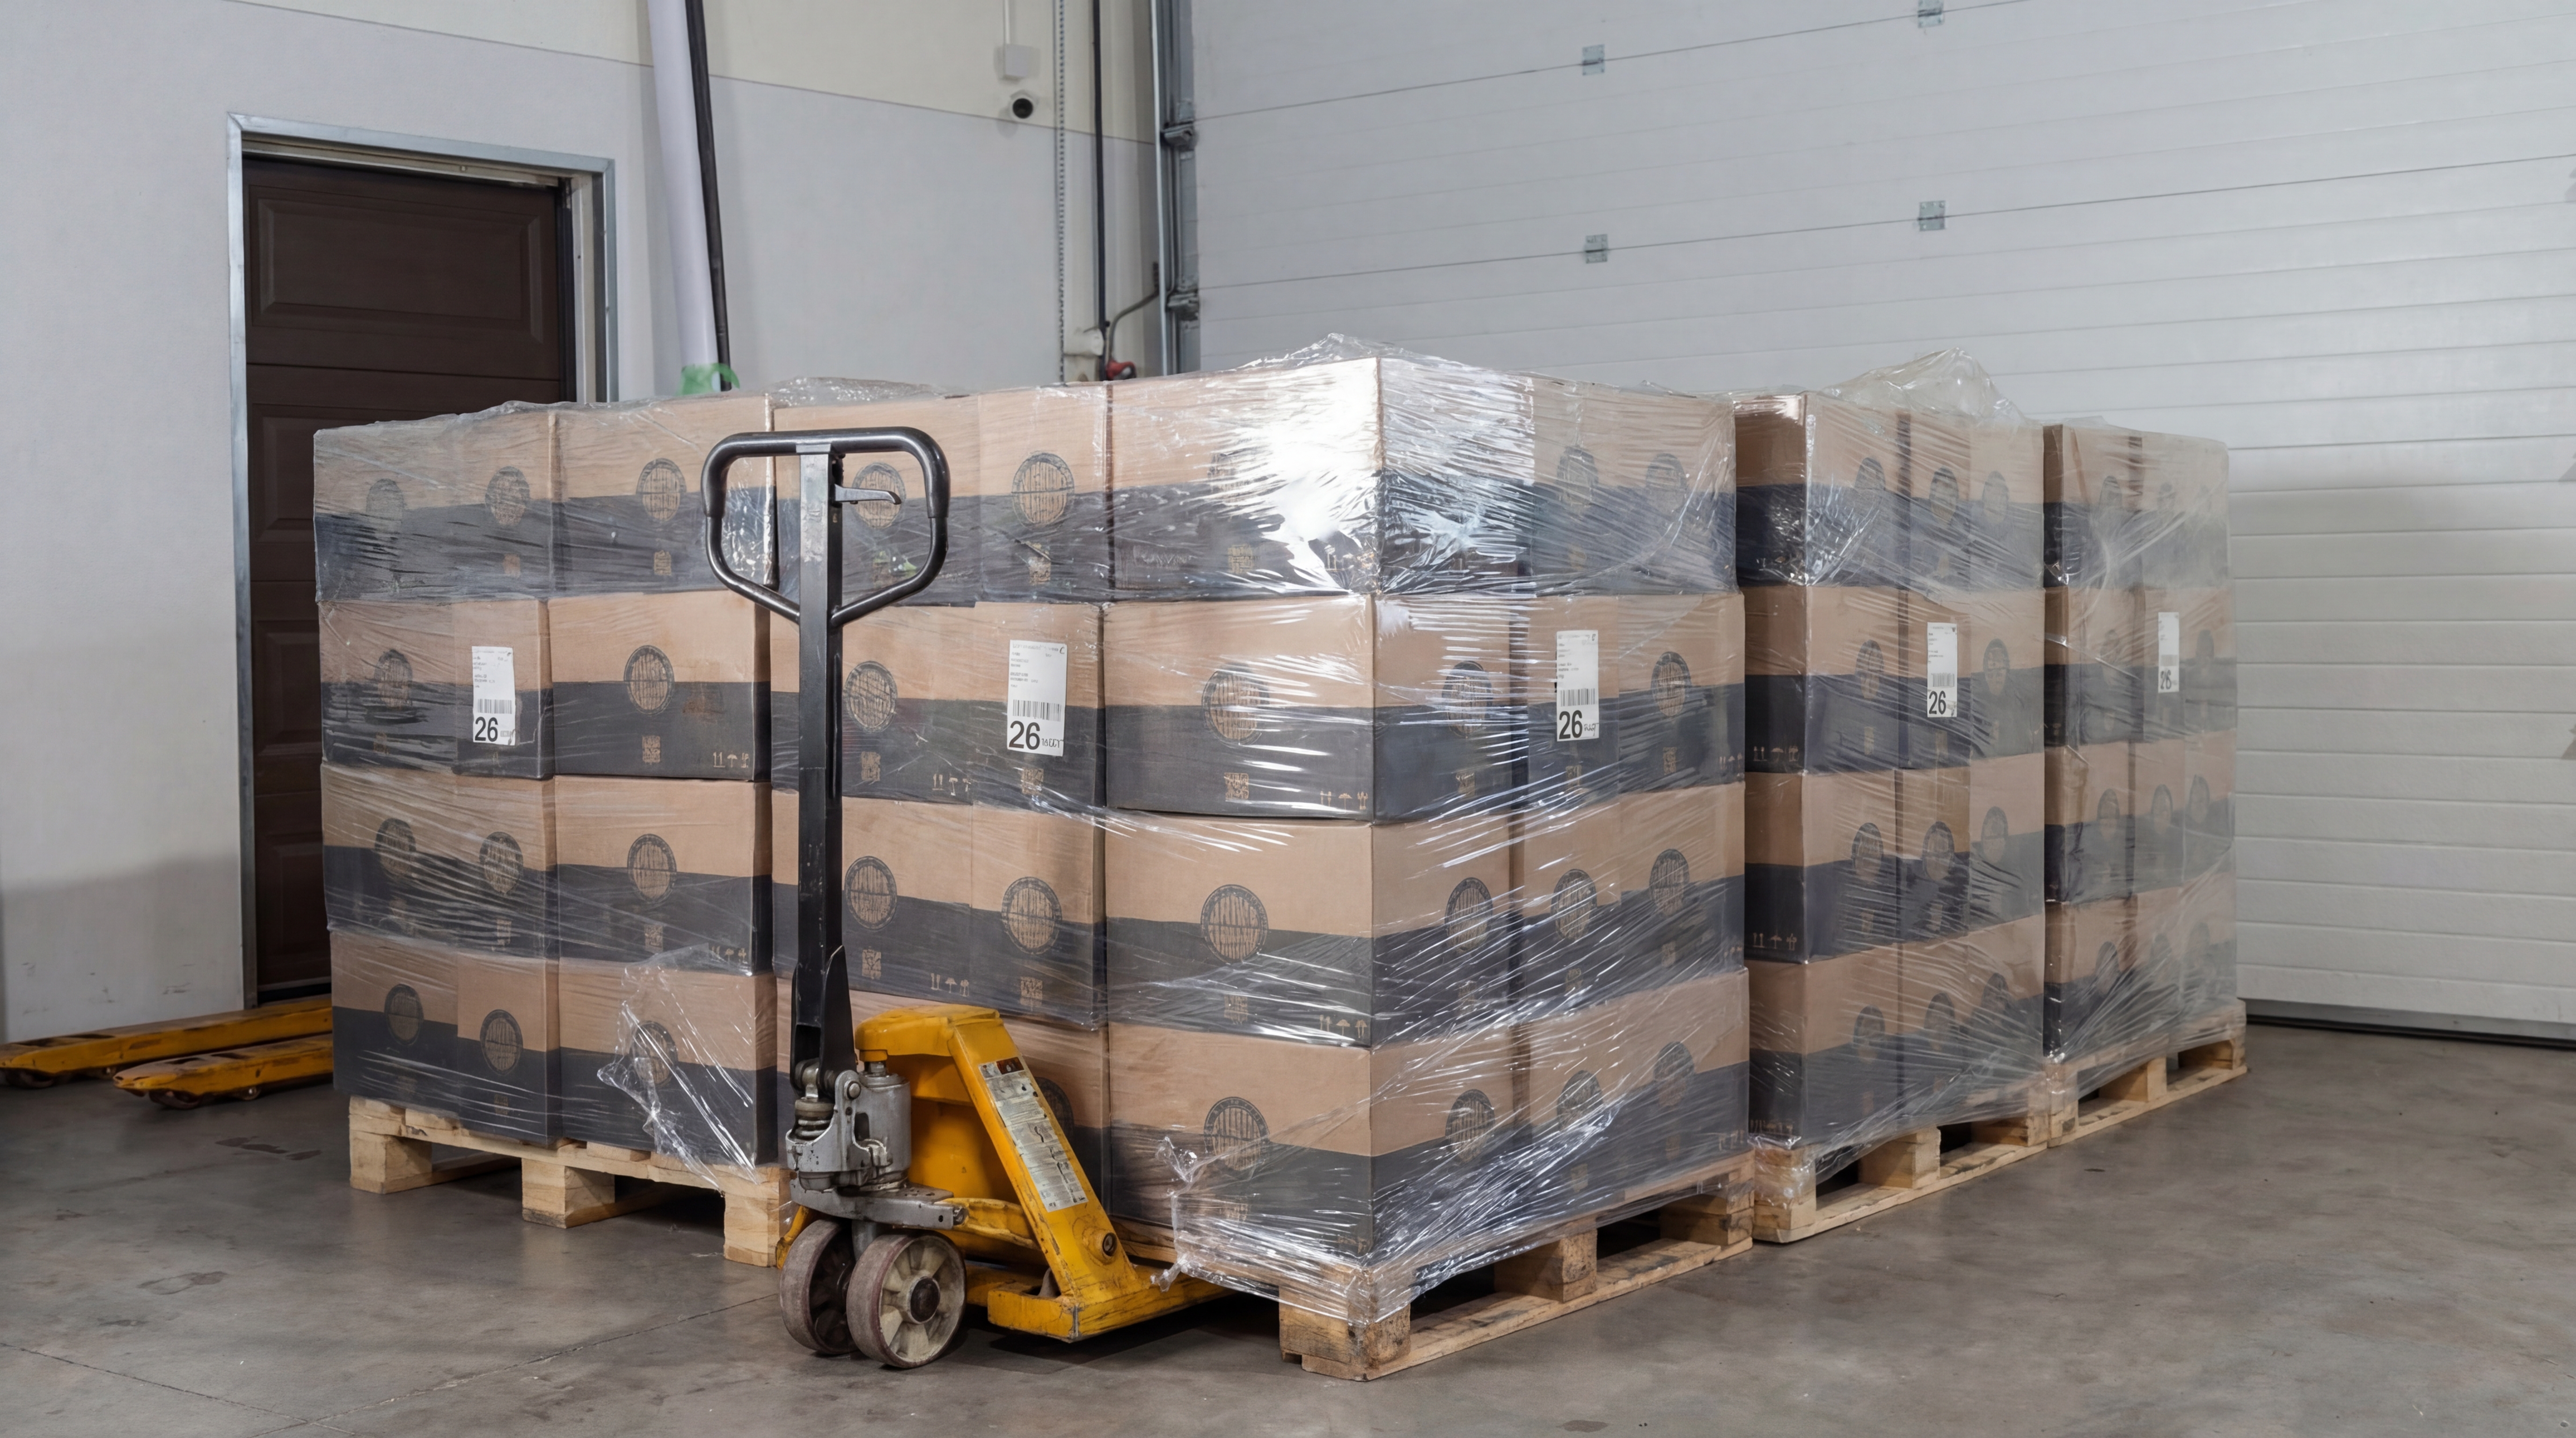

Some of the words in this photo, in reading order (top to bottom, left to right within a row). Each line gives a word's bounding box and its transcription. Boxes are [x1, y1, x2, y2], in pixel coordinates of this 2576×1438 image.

[1929, 690, 1946, 715] 26
[475, 717, 498, 742] 26
[1009, 721, 1040, 750] 26
[1559, 710, 1582, 739] 26
